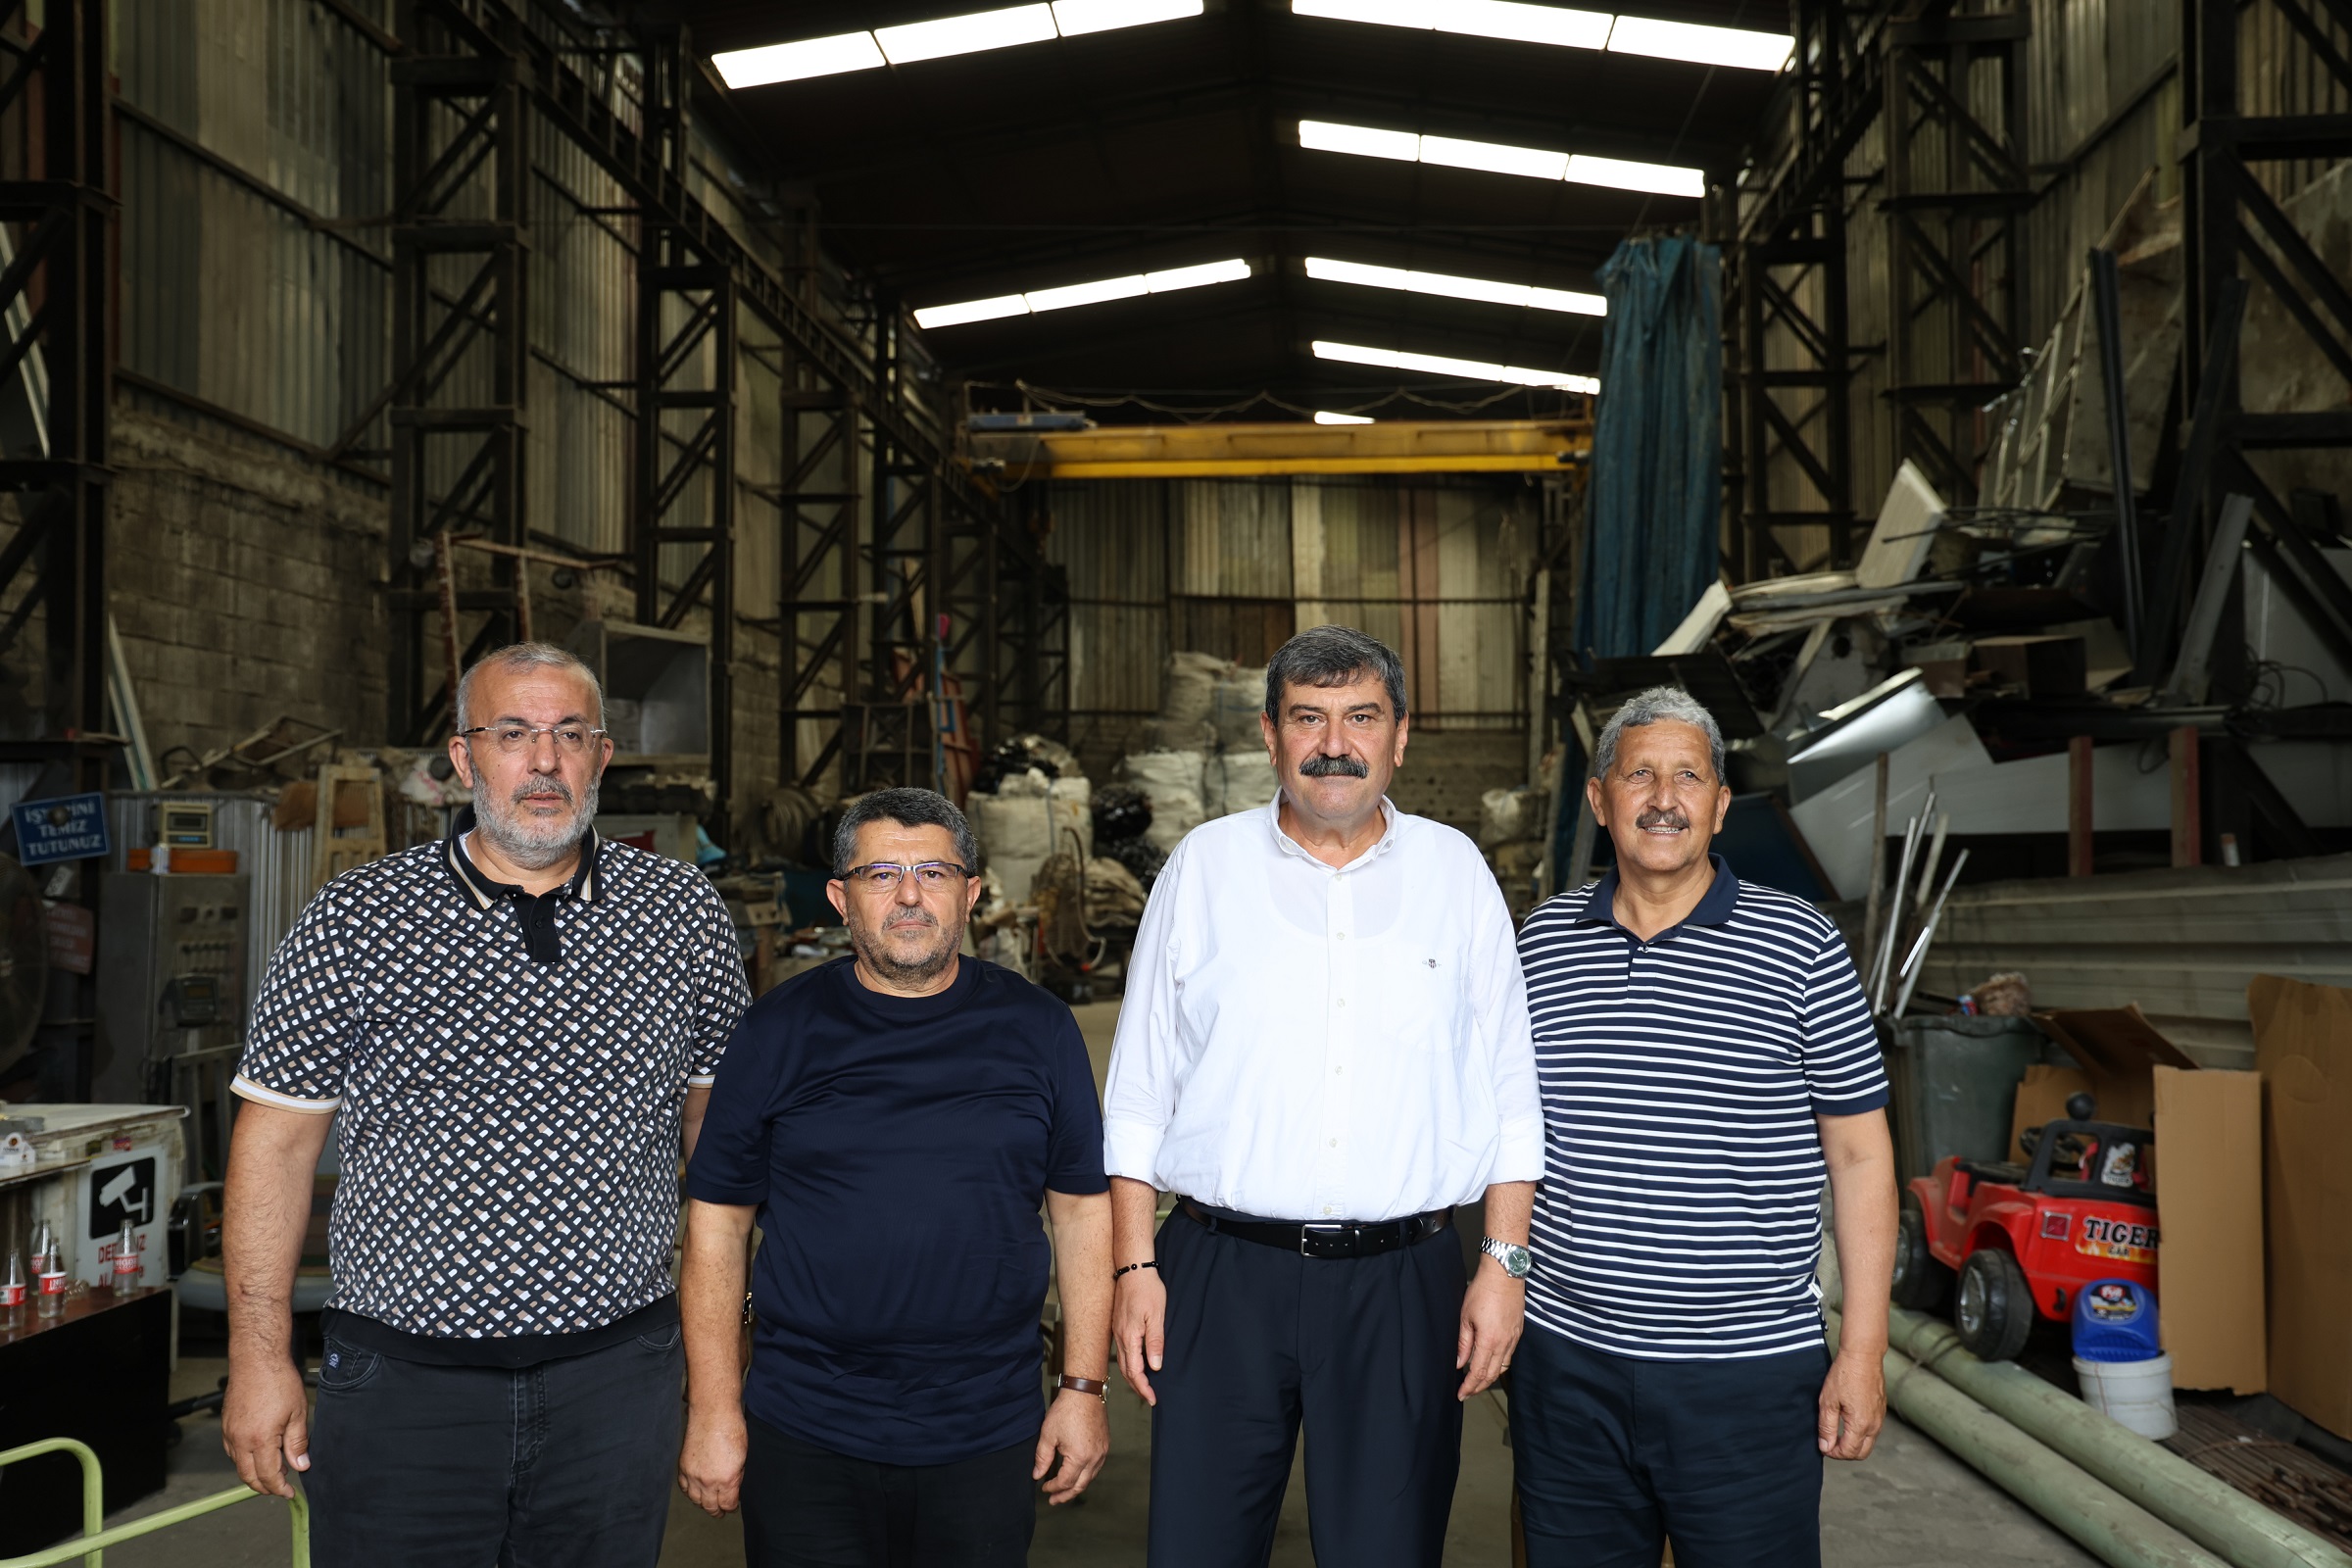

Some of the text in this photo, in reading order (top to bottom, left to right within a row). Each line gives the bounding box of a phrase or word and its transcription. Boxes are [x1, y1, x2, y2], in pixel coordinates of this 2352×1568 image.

[24, 799, 95, 825] İŞYİNİ
[37, 819, 88, 838] TEMİZ
[26, 834, 102, 857] TUTUNUZ
[2085, 1219, 2159, 1249] TIGER
[2108, 1245, 2130, 1256] CAR
